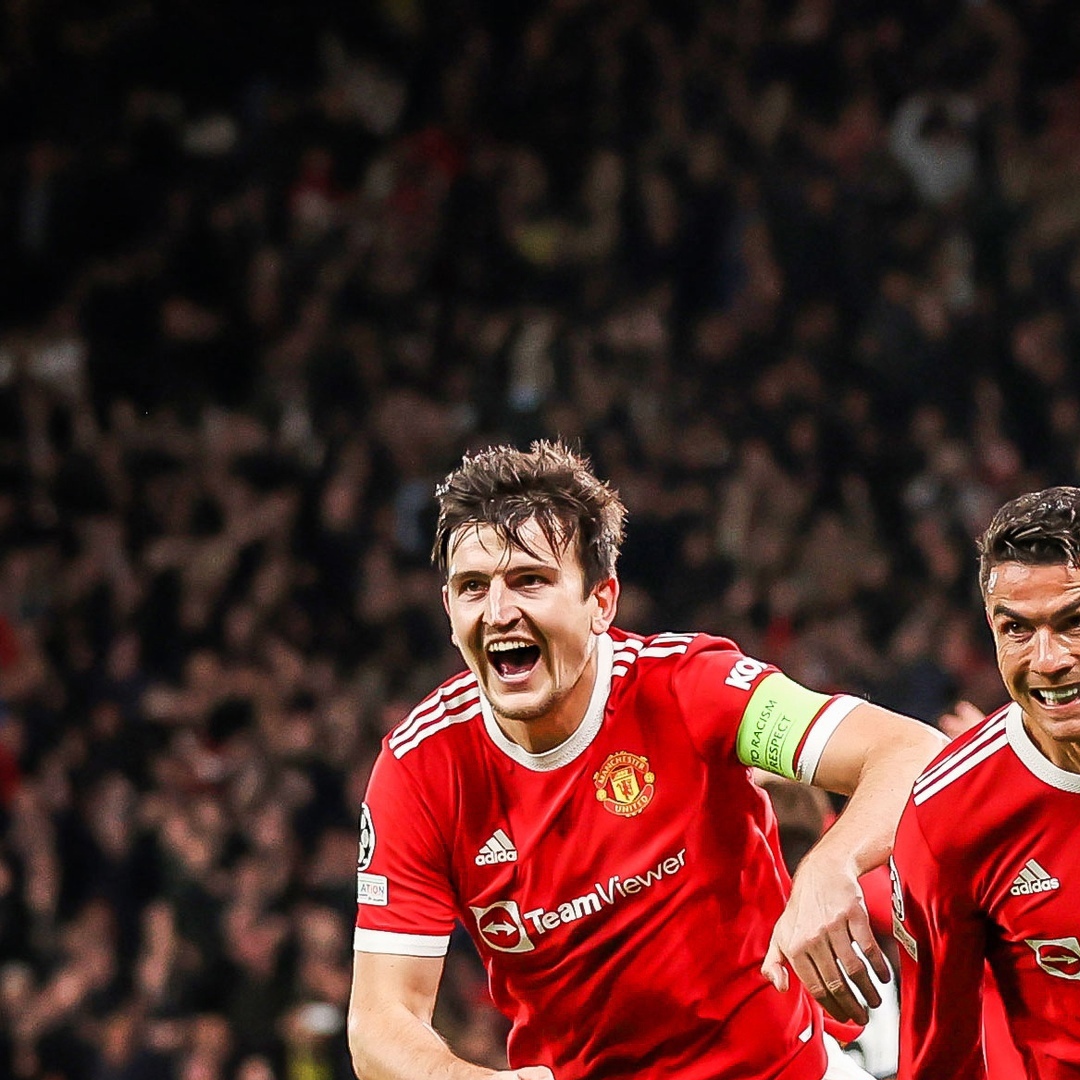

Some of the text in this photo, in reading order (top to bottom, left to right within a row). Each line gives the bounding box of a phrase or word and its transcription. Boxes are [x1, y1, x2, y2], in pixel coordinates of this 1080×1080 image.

[724, 656, 768, 691] KO
[751, 699, 778, 749] RACISM
[768, 714, 792, 769] RESPECT
[614, 795, 649, 814] UNITED
[524, 848, 686, 935] TeamViewer
[1010, 877, 1060, 896] adidas
